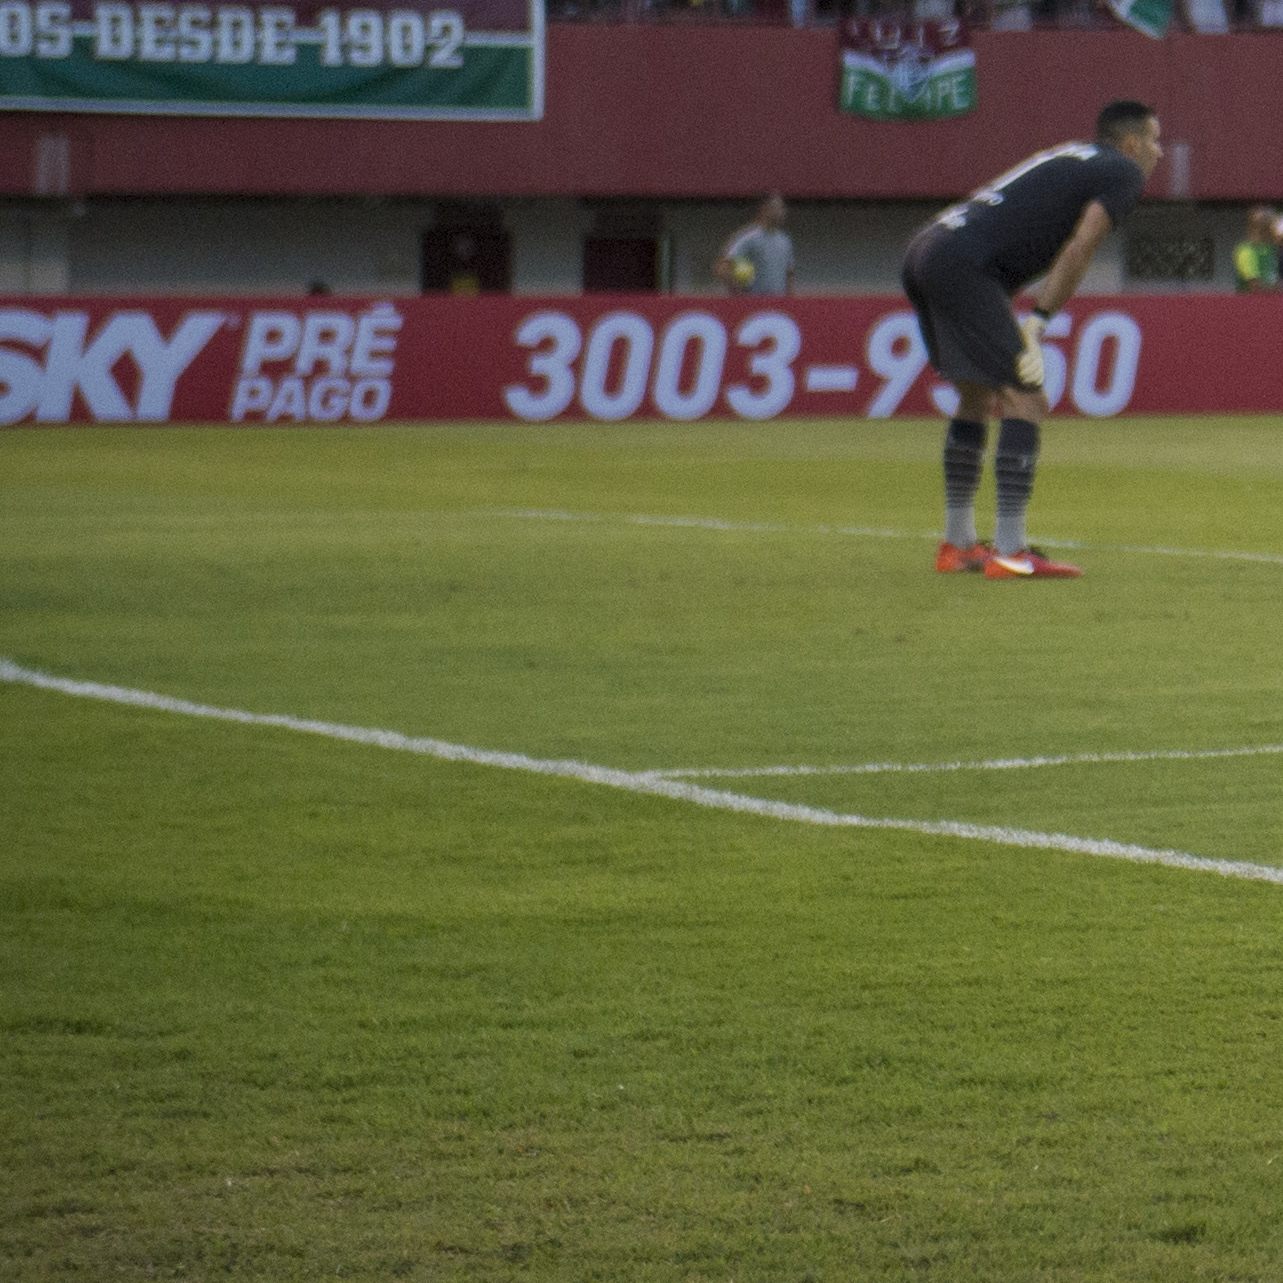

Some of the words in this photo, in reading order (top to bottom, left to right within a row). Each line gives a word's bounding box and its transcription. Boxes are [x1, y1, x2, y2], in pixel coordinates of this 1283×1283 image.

[95, 1, 296, 65] DESDE
[319, 7, 465, 70] 1902
[0, 309, 227, 423] SKY
[240, 302, 402, 377] PRÉ
[504, 310, 1143, 420] 3003-950
[230, 376, 393, 422] PAGO
